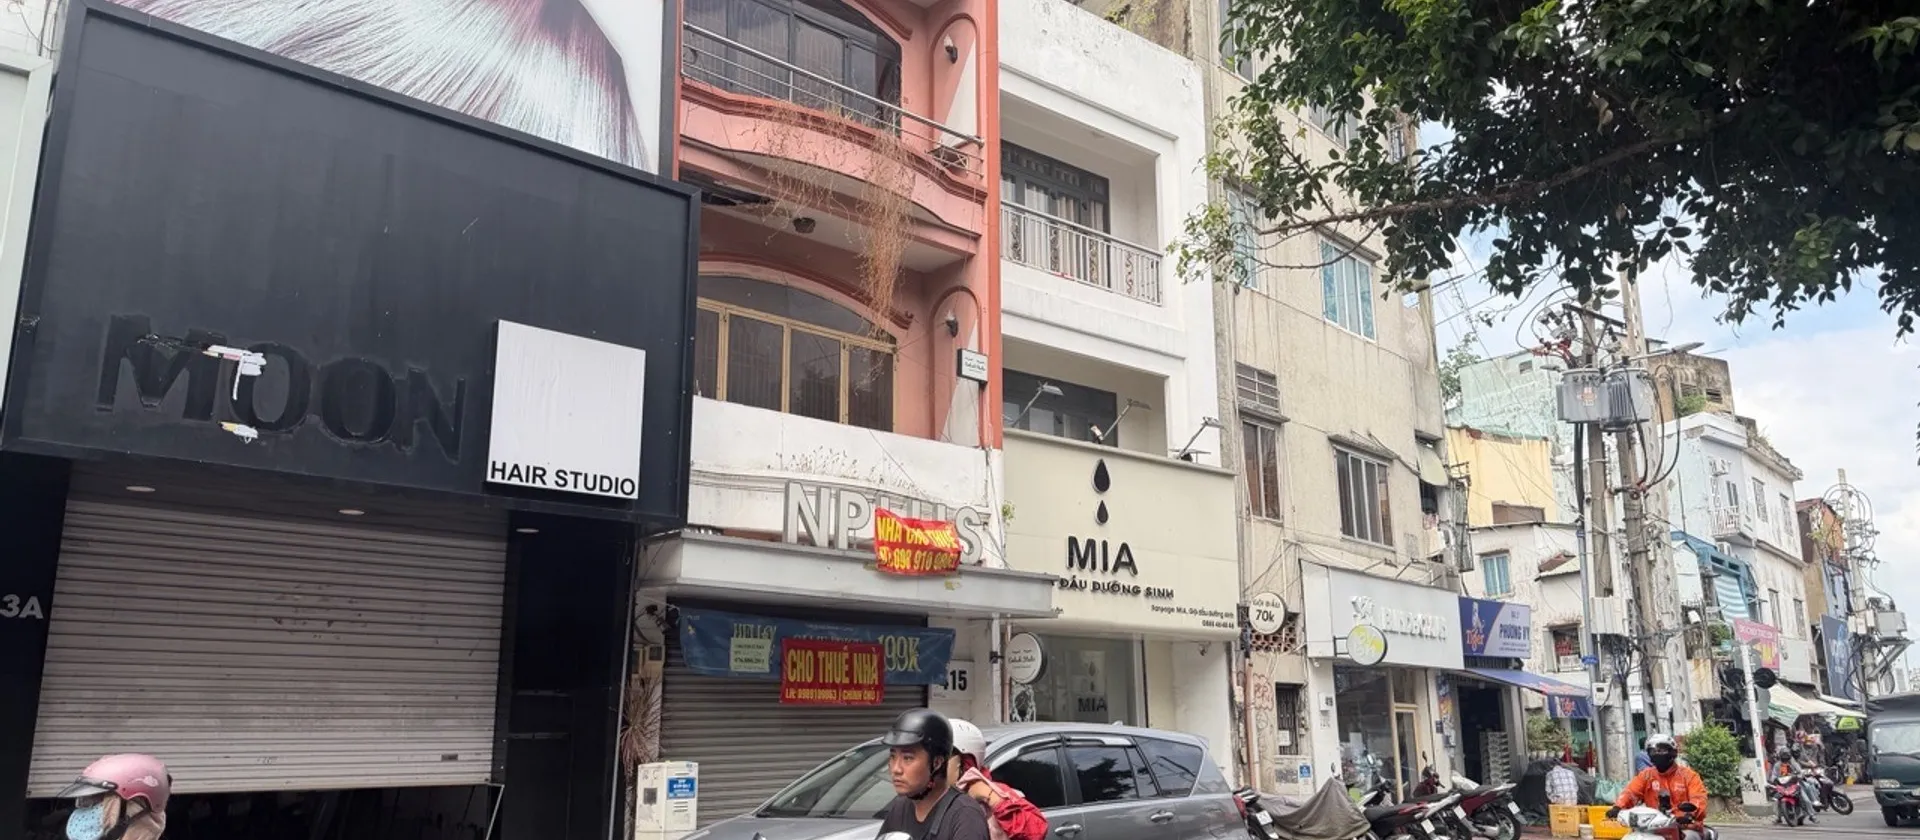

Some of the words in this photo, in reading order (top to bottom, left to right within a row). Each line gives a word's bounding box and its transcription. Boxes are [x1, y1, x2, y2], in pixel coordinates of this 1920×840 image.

[97, 313, 466, 465] MOON
[491, 460, 547, 486] HAIR
[554, 469, 636, 496] STUDIO
[1067, 535, 1139, 577] MIA
[1144, 587, 1174, 600] SINH
[1255, 609, 1275, 622] 70k
[787, 648, 814, 683] CHO
[853, 647, 879, 685] NHÀ
[1078, 697, 1108, 713] MIA
